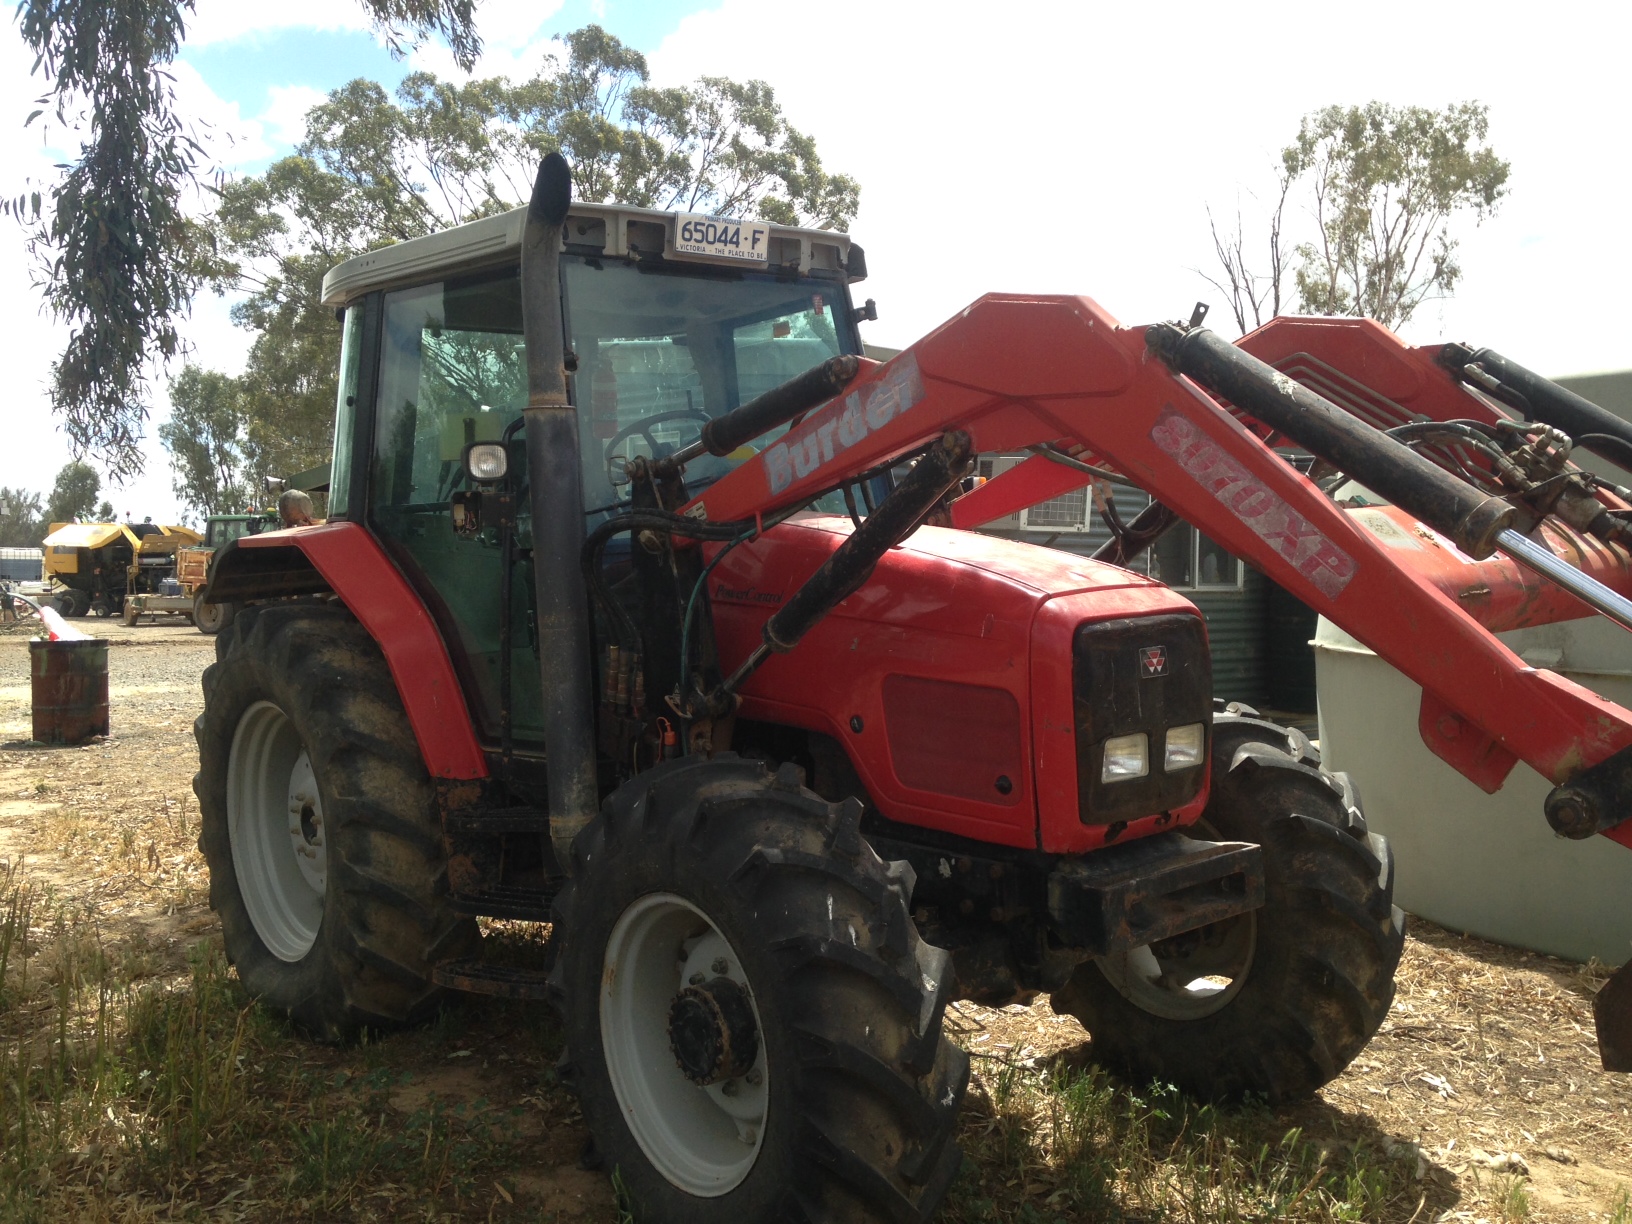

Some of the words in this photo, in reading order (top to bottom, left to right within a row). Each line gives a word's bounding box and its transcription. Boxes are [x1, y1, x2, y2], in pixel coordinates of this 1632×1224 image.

[680, 244, 706, 252] VICTORIA
[747, 251, 755, 259] TO
[764, 366, 918, 497] Burder
